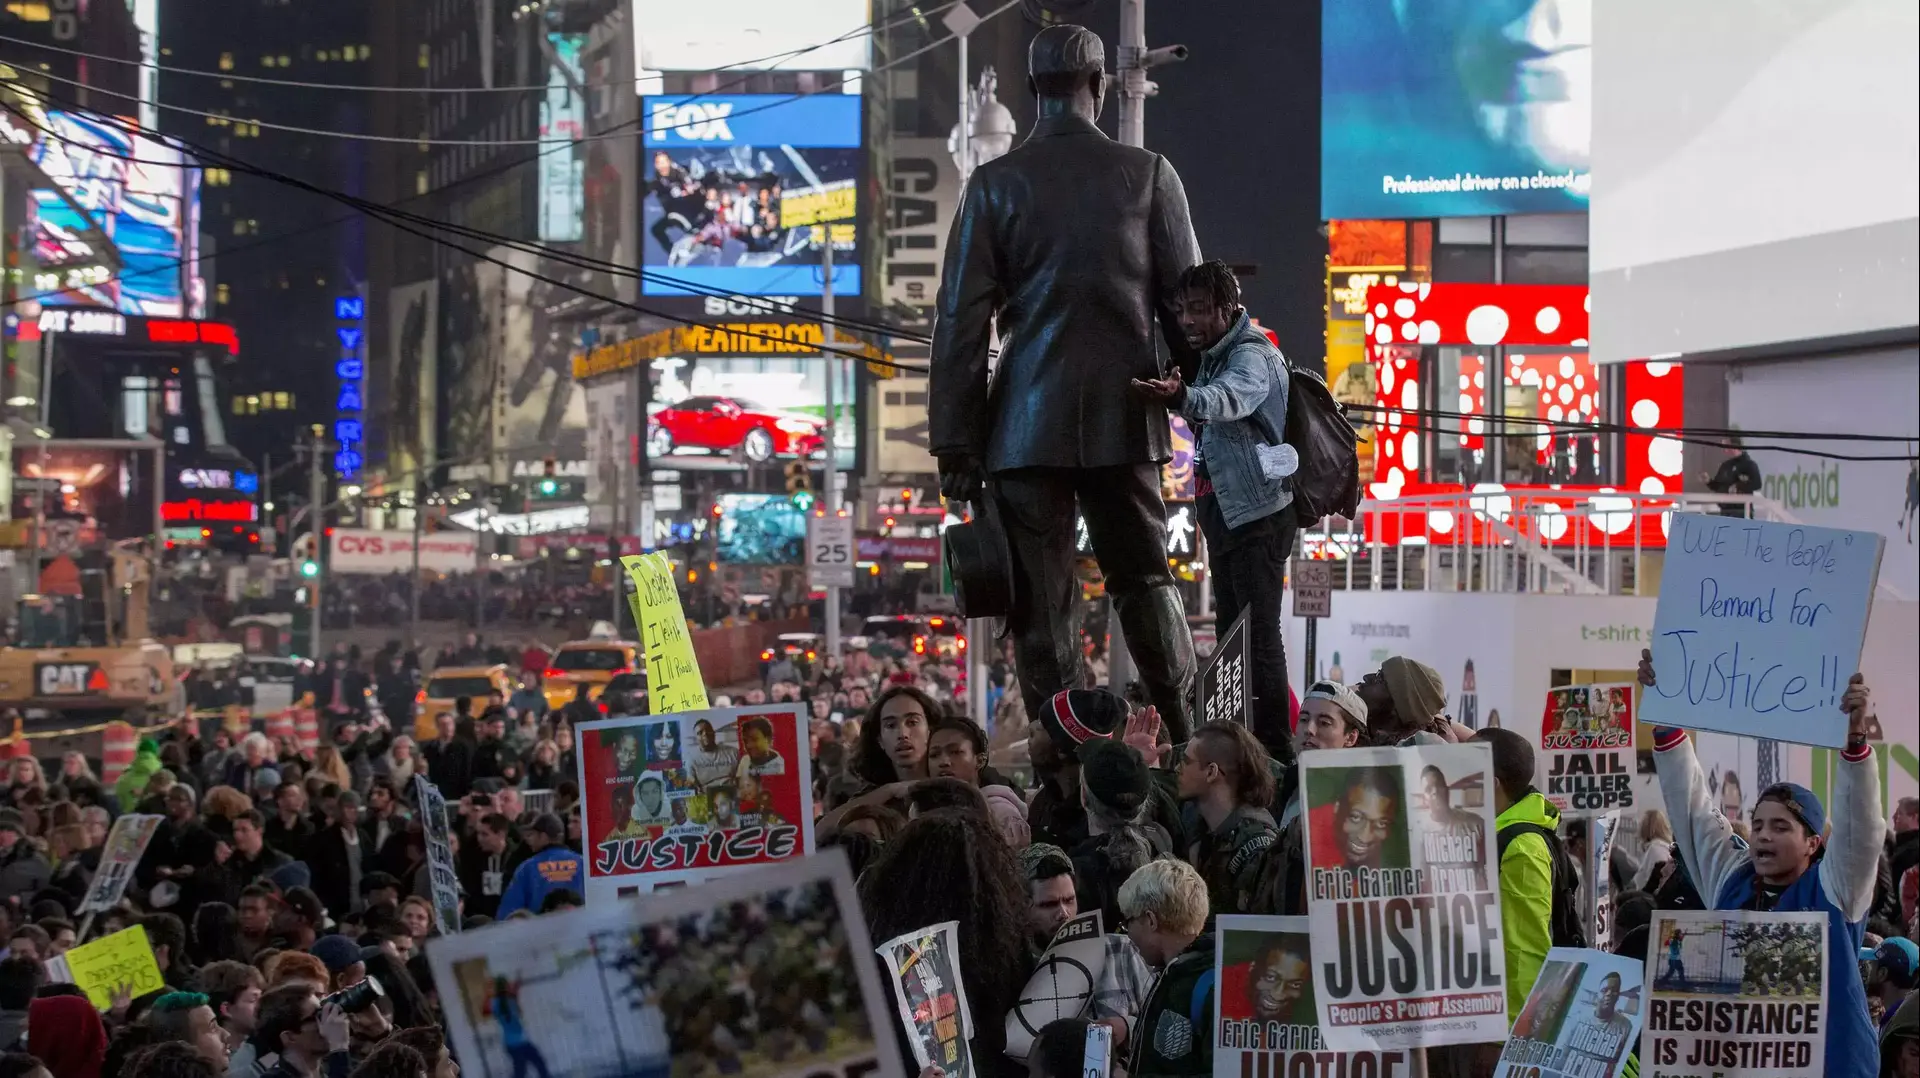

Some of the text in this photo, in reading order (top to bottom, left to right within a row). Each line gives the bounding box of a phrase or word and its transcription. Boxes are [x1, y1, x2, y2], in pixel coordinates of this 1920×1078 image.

[652, 103, 735, 140] FOX
[1383, 173, 1460, 193] Professional
[1461, 172, 1500, 191] driver
[1501, 176, 1519, 190] on
[1520, 176, 1530, 190] a
[1530, 169, 1573, 188] closed
[887, 157, 938, 286] CALL
[704, 295, 799, 315] SONY
[906, 282, 924, 300] OF
[335, 296, 364, 472] NYGARD
[1763, 459, 1839, 510] android
[338, 535, 384, 554] CVS
[815, 544, 848, 564] 25
[1742, 525, 1774, 563] The
[1298, 588, 1327, 599] WALK
[1299, 601, 1324, 612] BIKE
[1699, 577, 1832, 627] Demand For
[1581, 624, 1641, 641] t-shirt
[41, 664, 90, 694] CAT
[1216, 655, 1225, 714] PEPPER
[1232, 653, 1242, 717] POLICE
[1655, 630, 1839, 713] Justice!!
[1223, 660, 1232, 721] PUT YOU
[1544, 732, 1631, 750] JUSTICE
[1548, 752, 1627, 776] JAIL
[1548, 774, 1631, 794] KILLER
[1571, 791, 1633, 809] COPS
[596, 825, 798, 875] JUSTICE
[1423, 831, 1478, 863] Michael
[1312, 864, 1424, 901] Eric Garner
[1430, 865, 1476, 893] Brown
[1056, 920, 1093, 940] ORE
[1323, 893, 1502, 999] JUSTICE
[1329, 995, 1504, 1025] People's Power Assembly
[1648, 1000, 1820, 1035] RESISTANCE
[1221, 1018, 1261, 1050] Eric
[1568, 1020, 1625, 1061] Michael
[1653, 1037, 1811, 1068] IS JUSTIFIED
